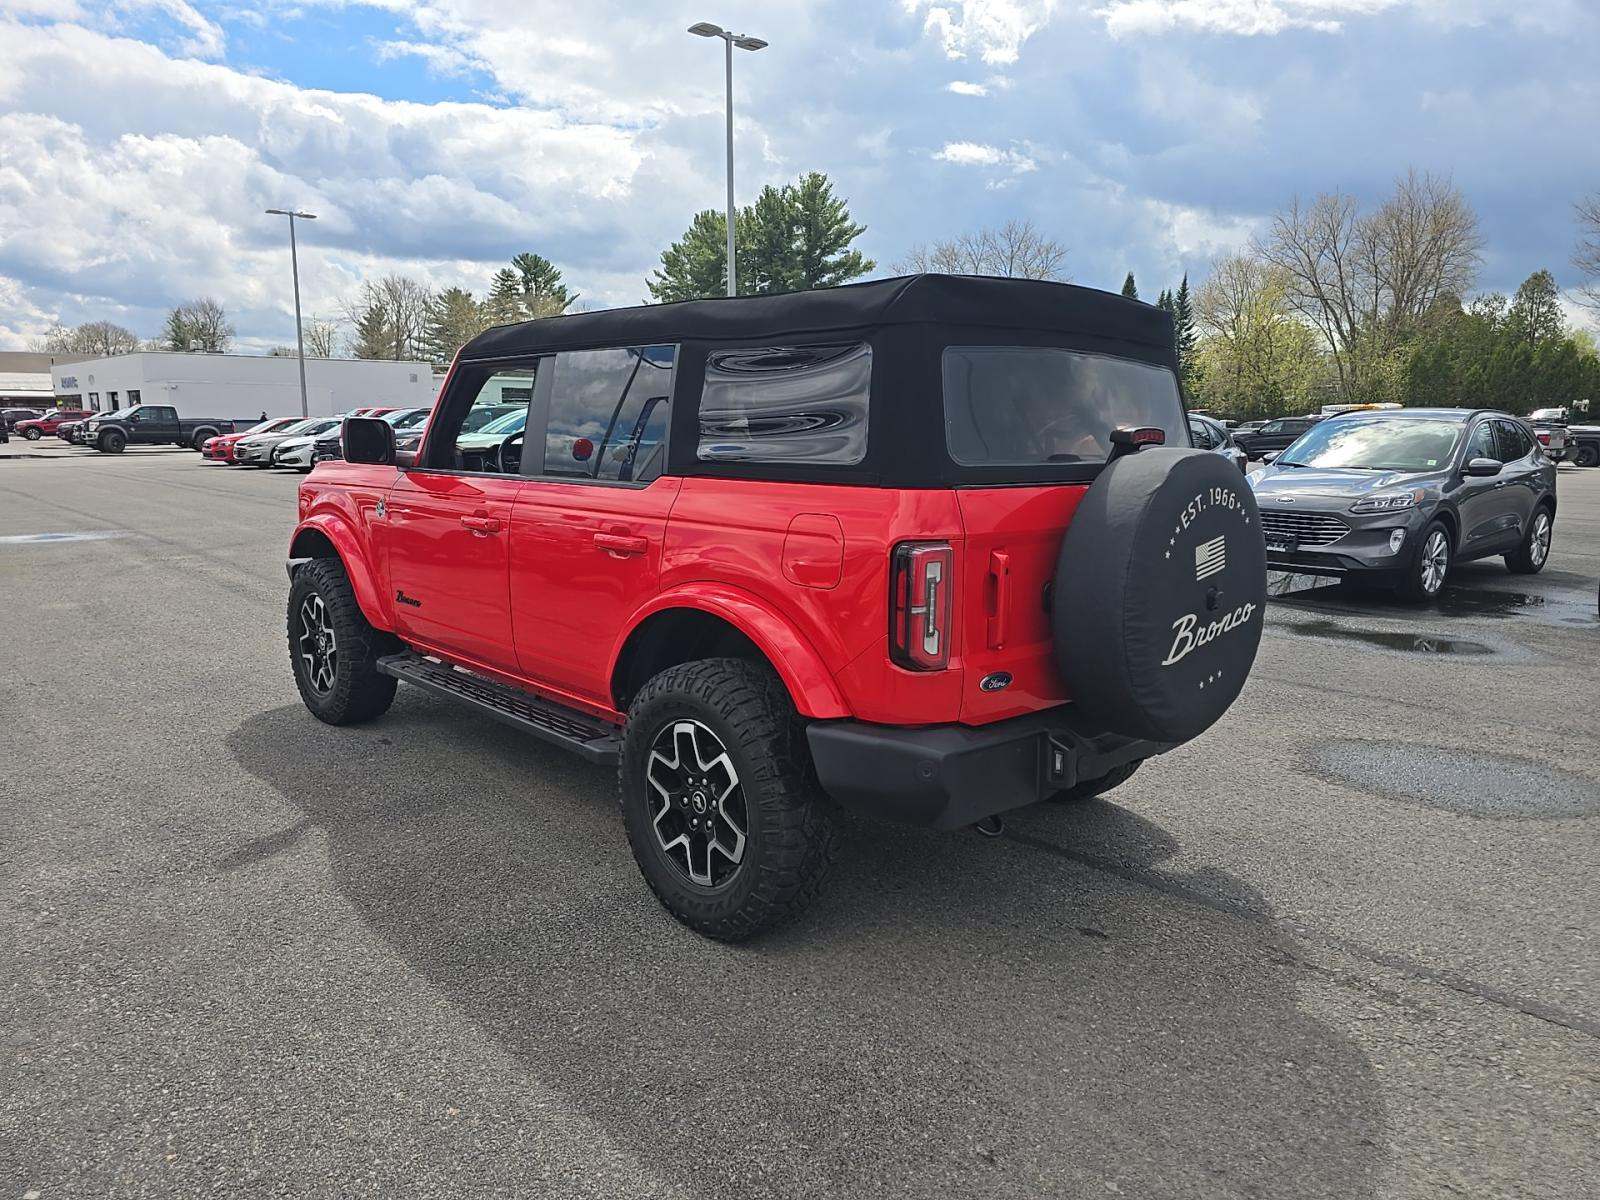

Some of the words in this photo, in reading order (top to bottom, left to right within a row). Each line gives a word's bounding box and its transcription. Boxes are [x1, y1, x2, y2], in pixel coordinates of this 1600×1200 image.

[1181, 494, 1207, 530] EST.
[1209, 487, 1236, 510] 1966
[1161, 602, 1257, 666] Bronco
